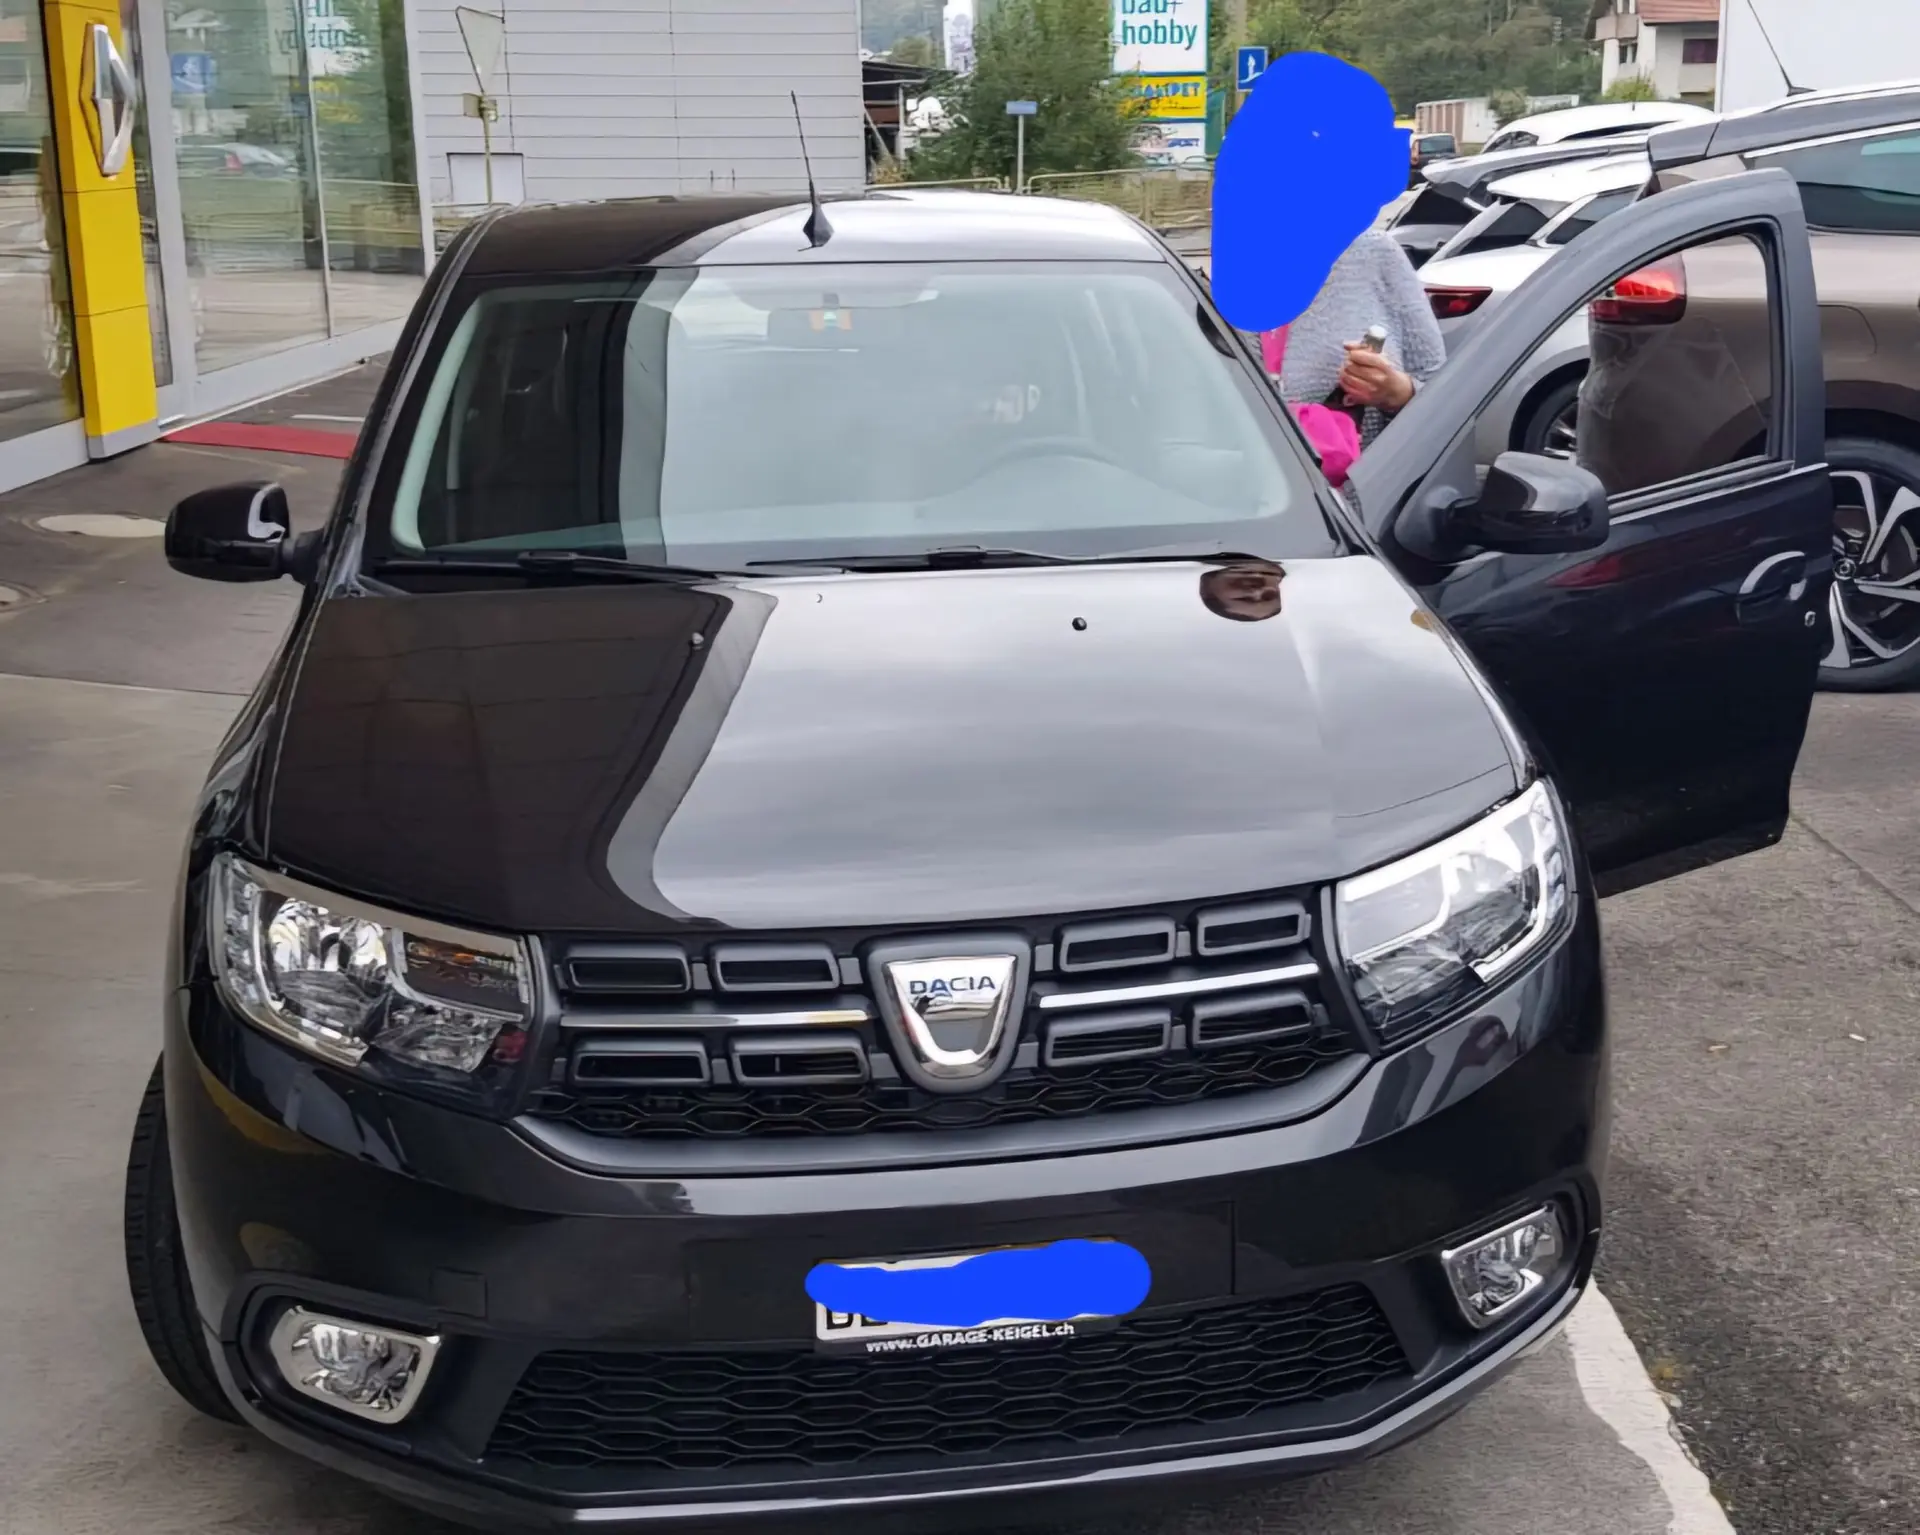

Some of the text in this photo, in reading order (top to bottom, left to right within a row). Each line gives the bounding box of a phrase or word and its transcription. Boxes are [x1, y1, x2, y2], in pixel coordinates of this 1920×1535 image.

[1122, 18, 1197, 50] hobby
[909, 975, 996, 995] DACIA
[865, 1321, 1075, 1352] www.GARAGE-KEIGEL.ch
